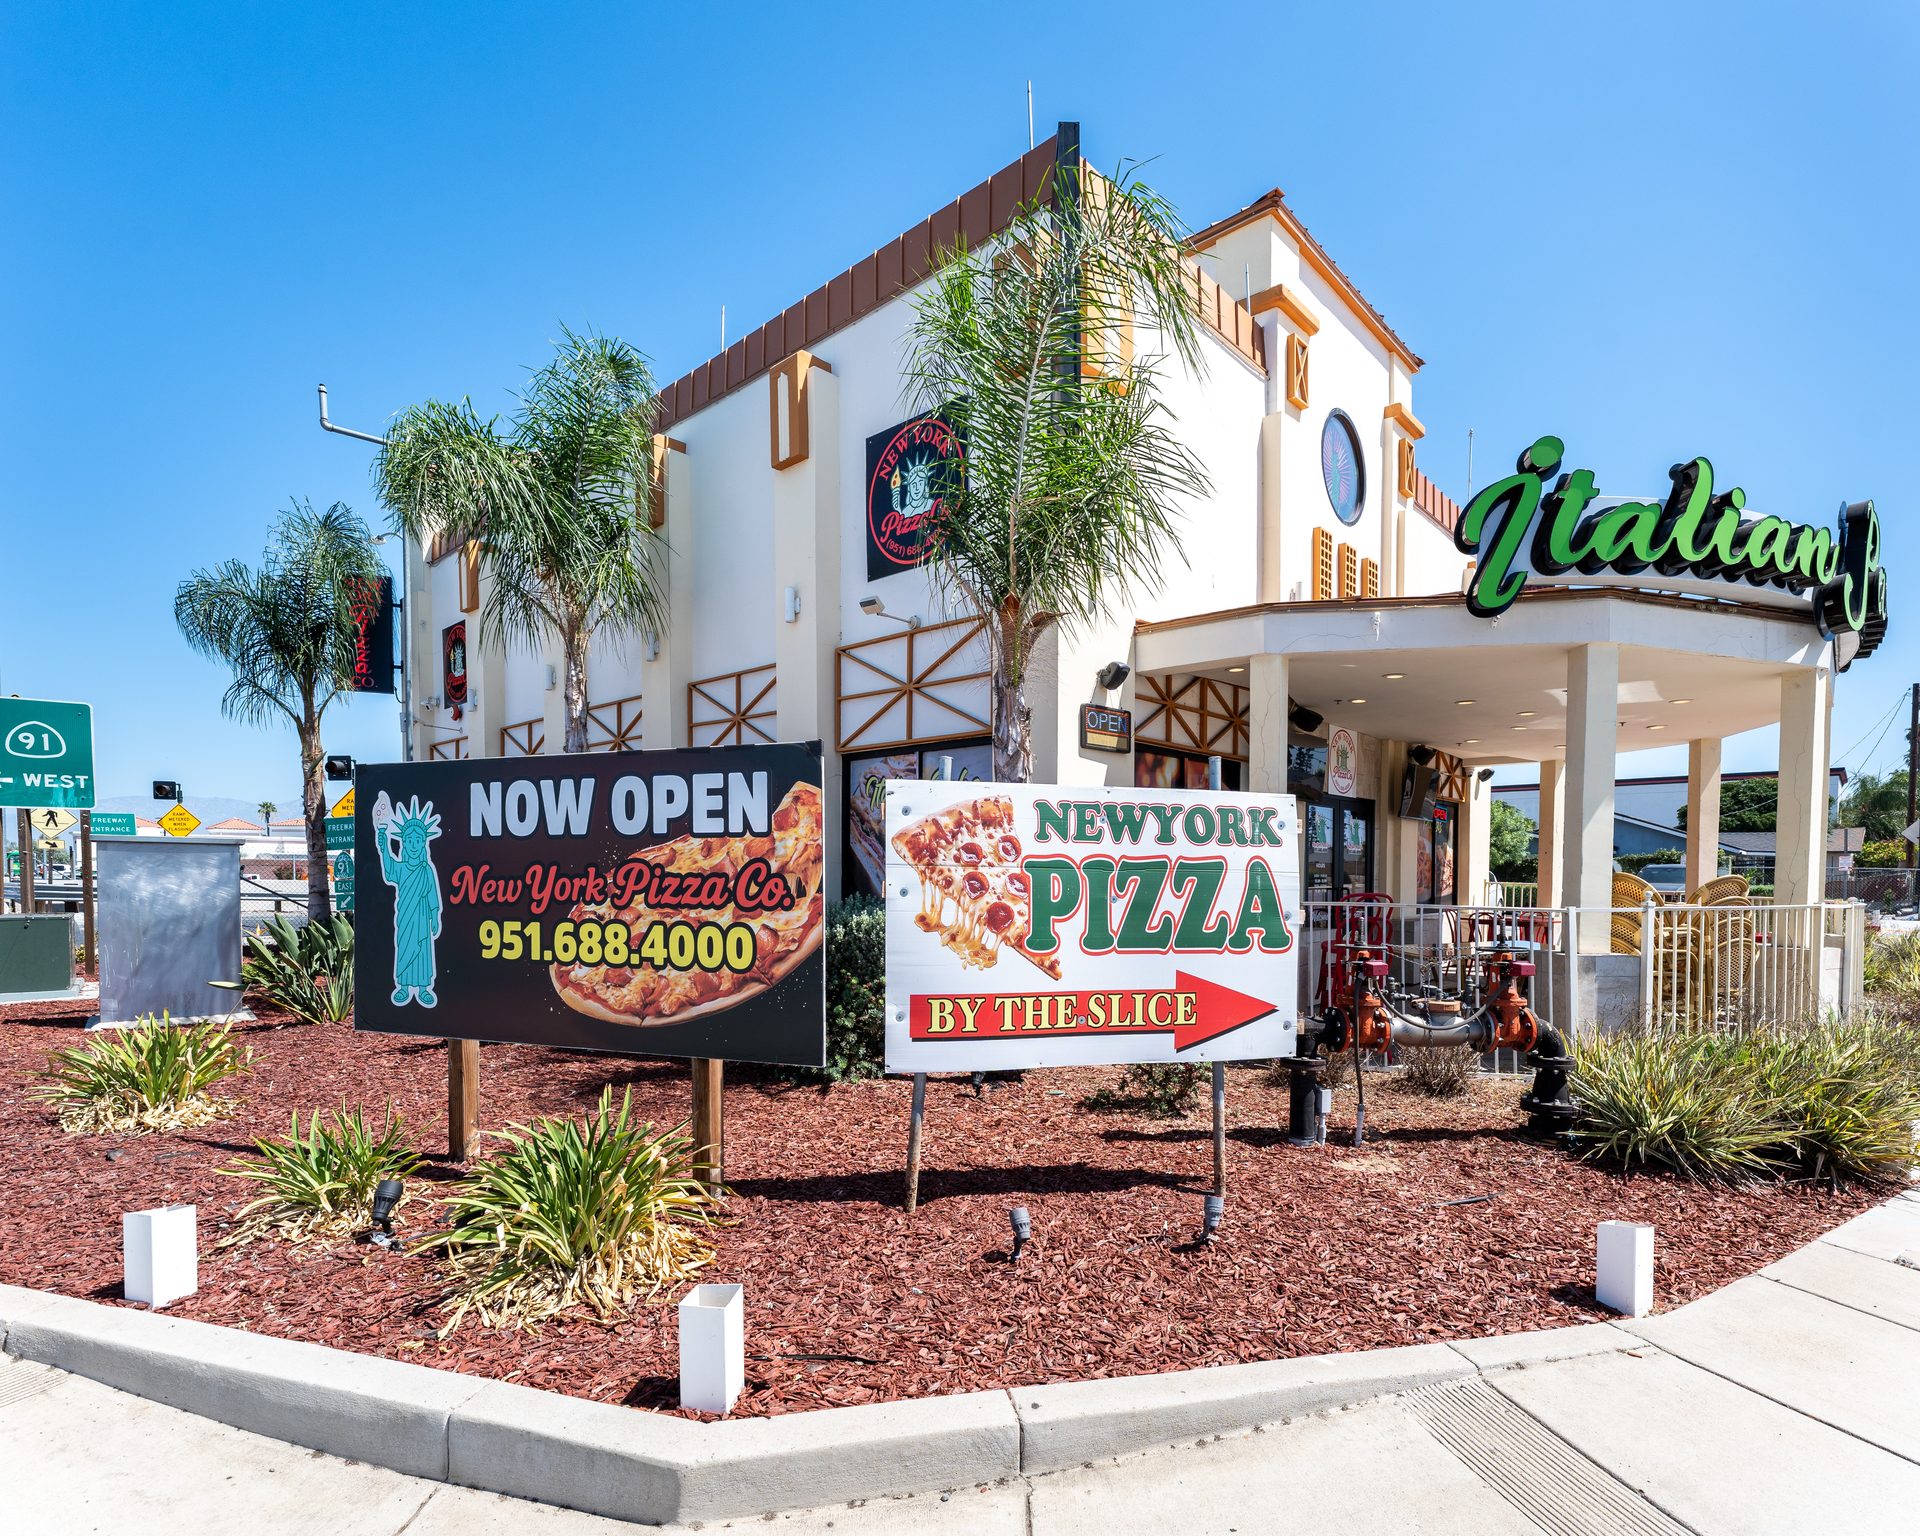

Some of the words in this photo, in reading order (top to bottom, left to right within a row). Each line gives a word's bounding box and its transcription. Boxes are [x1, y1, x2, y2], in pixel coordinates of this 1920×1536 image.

[879, 433, 910, 481] NEW
[913, 425, 950, 458] YORK
[1087, 711, 1127, 734] OPEN
[17, 732, 50, 751] 91
[23, 772, 89, 789] WEST
[470, 777, 596, 837] NOW
[611, 771, 768, 836] OPEN
[326, 835, 355, 844] ENTRANC
[337, 861, 350, 874] 91
[337, 882, 352, 891] EAST
[450, 864, 523, 905] New
[525, 864, 606, 914] York
[613, 862, 730, 908] Pizza
[734, 861, 793, 908] Co.
[1021, 853, 1293, 956] PIZZA
[478, 919, 755, 970] 951.688.4000
[927, 997, 988, 1035] BY
[993, 993, 1078, 1031] THE
[1086, 990, 1198, 1028] SLICE
